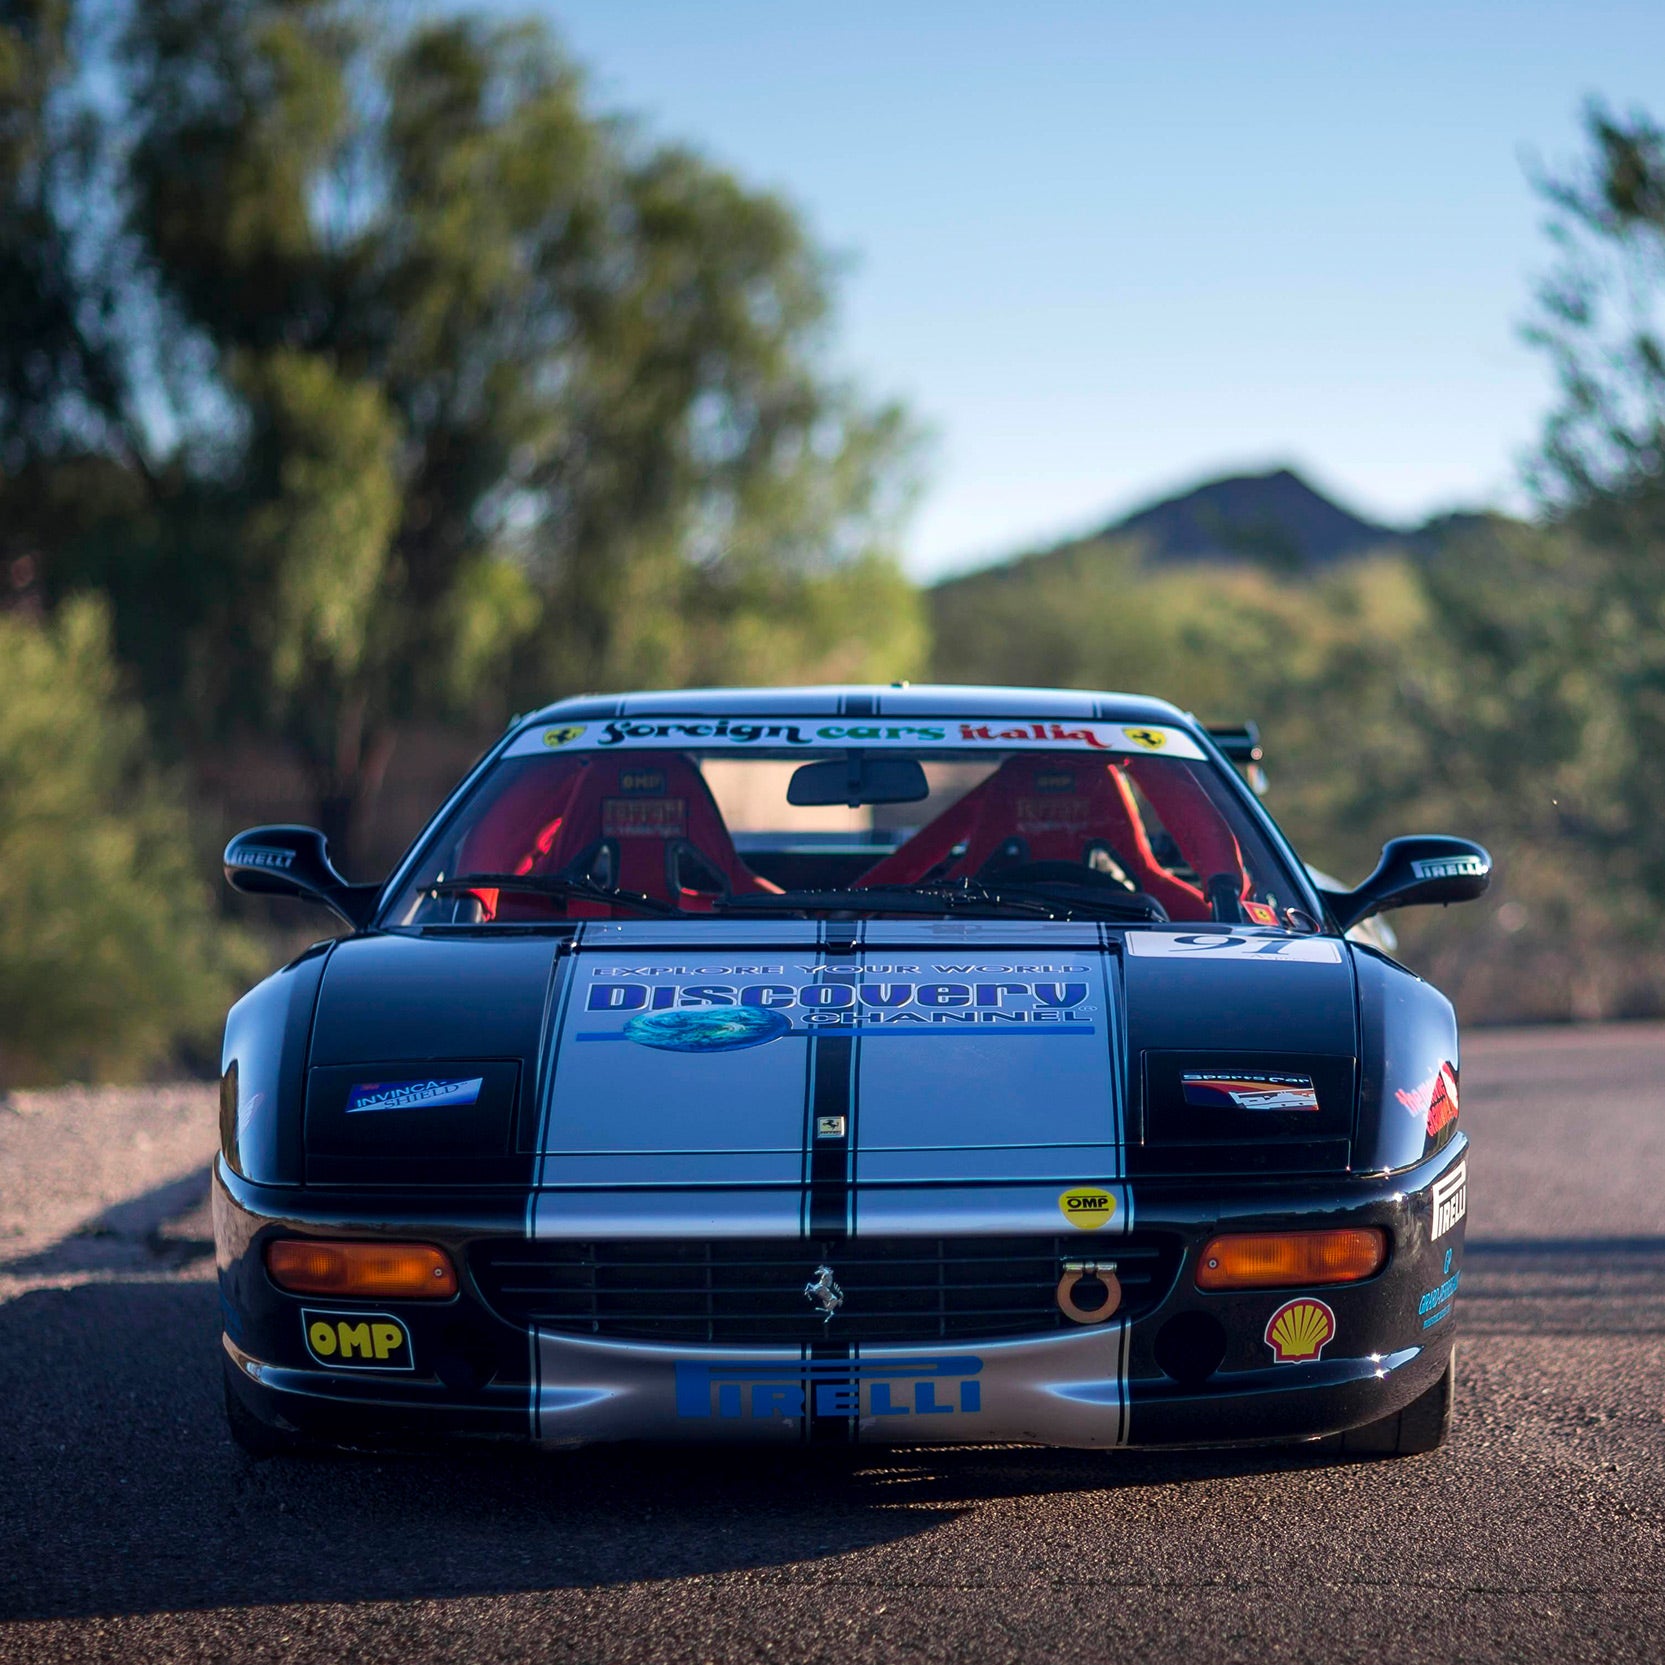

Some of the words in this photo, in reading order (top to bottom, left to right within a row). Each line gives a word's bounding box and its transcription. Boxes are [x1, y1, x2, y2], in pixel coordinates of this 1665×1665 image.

[816, 725, 946, 740] cars
[230, 846, 296, 868] PIRELLI
[1410, 855, 1482, 879] PIRELLI
[592, 965, 784, 977] EXPLORE
[794, 964, 922, 975] YOUR
[931, 964, 1093, 975] WORLD
[800, 1010, 1094, 1024] CHANNEL
[1066, 1196, 1109, 1210] OMP
[309, 1320, 403, 1360] OMP
[675, 1355, 984, 1418] PIRELLI
